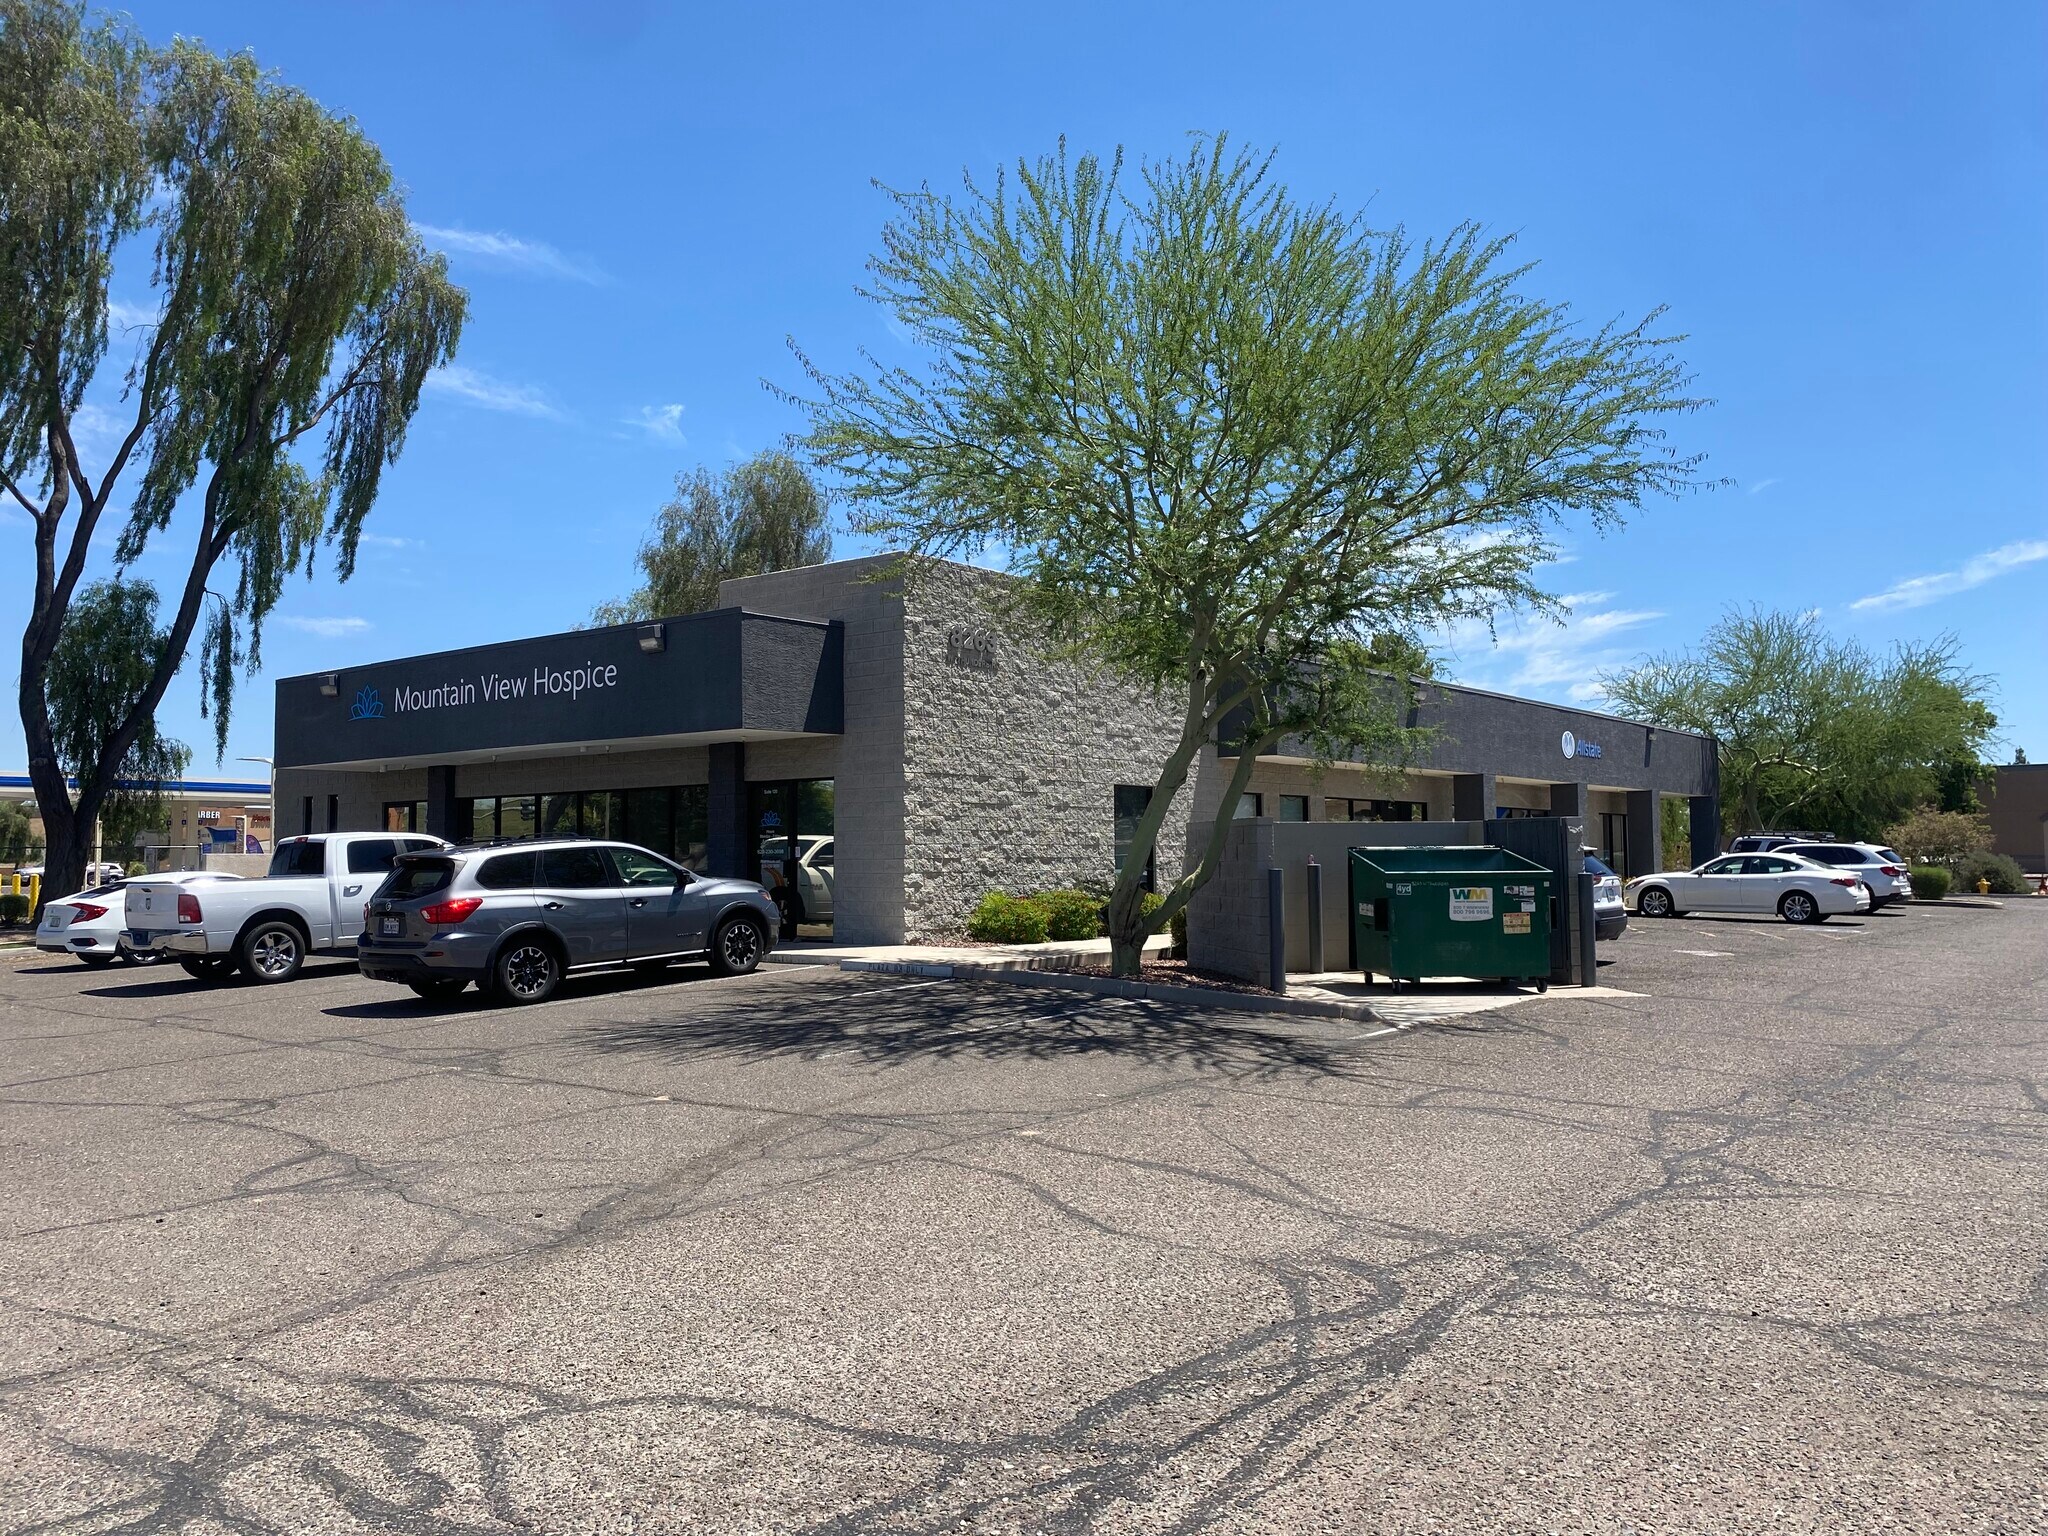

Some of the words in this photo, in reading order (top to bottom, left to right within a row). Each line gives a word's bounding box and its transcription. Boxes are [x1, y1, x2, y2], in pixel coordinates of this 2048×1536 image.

[950, 625, 997, 653] 8263
[394, 678, 475, 712] Mountain
[481, 673, 527, 702] View
[534, 660, 618, 700] Hospice
[1576, 739, 1601, 760] Allstate
[1397, 884, 1411, 893] 4yd
[1453, 889, 1488, 900] WM
